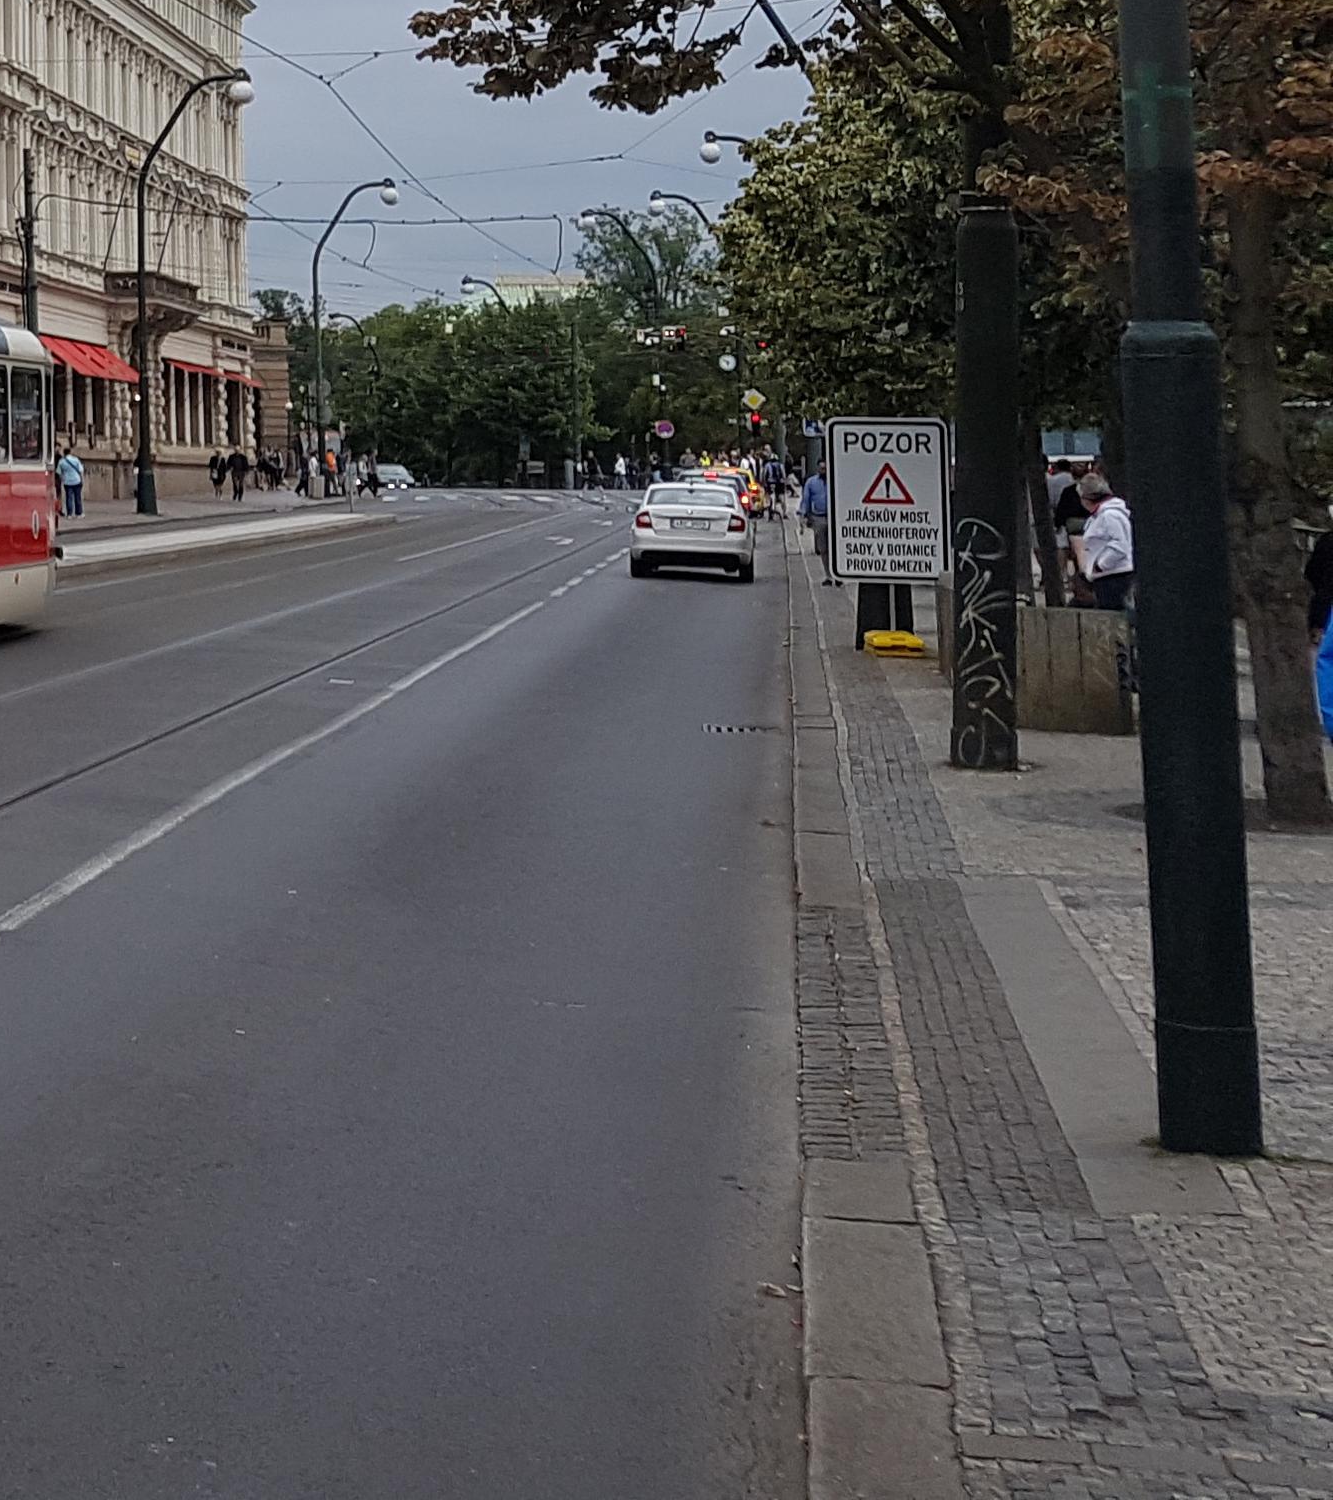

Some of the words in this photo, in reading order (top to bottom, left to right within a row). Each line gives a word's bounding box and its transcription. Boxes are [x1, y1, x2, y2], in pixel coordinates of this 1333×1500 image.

[843, 432, 932, 454] POZOR
[845, 507, 897, 523] JIRÁSKŮV
[900, 511, 931, 525] MOST,
[841, 526, 939, 540] DIENZENHOFEROVY
[845, 543, 874, 557] SADY,
[876, 543, 885, 557] V
[887, 543, 937, 558] BOTANICE
[846, 558, 886, 572] PROVOZ
[890, 559, 933, 573] OMEZEN
